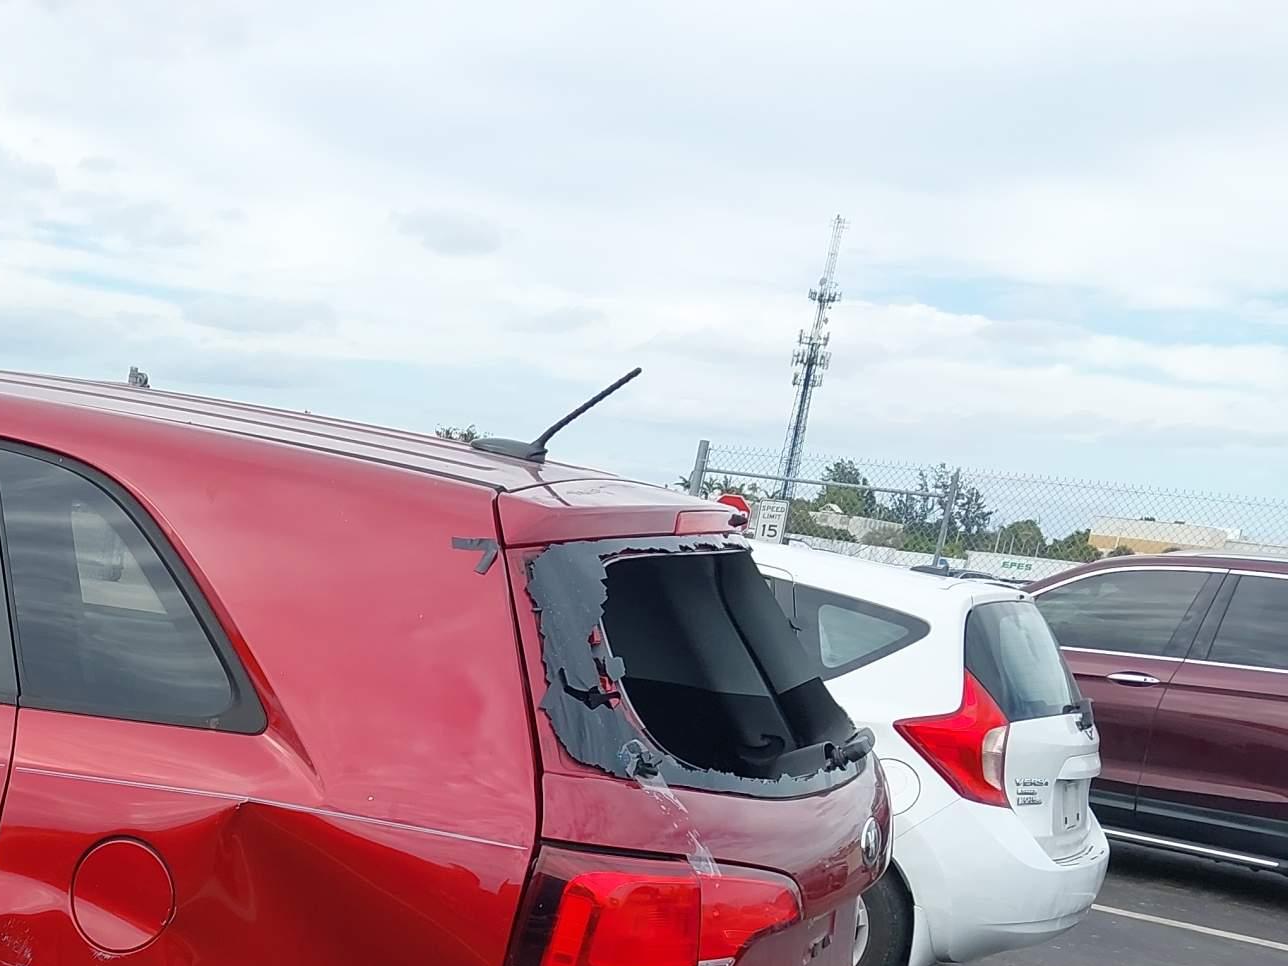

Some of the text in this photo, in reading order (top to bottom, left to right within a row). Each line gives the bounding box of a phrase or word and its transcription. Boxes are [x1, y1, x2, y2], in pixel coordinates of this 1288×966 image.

[761, 504, 786, 513] SPEED
[762, 512, 782, 520] LIMIT
[761, 524, 778, 538] 15
